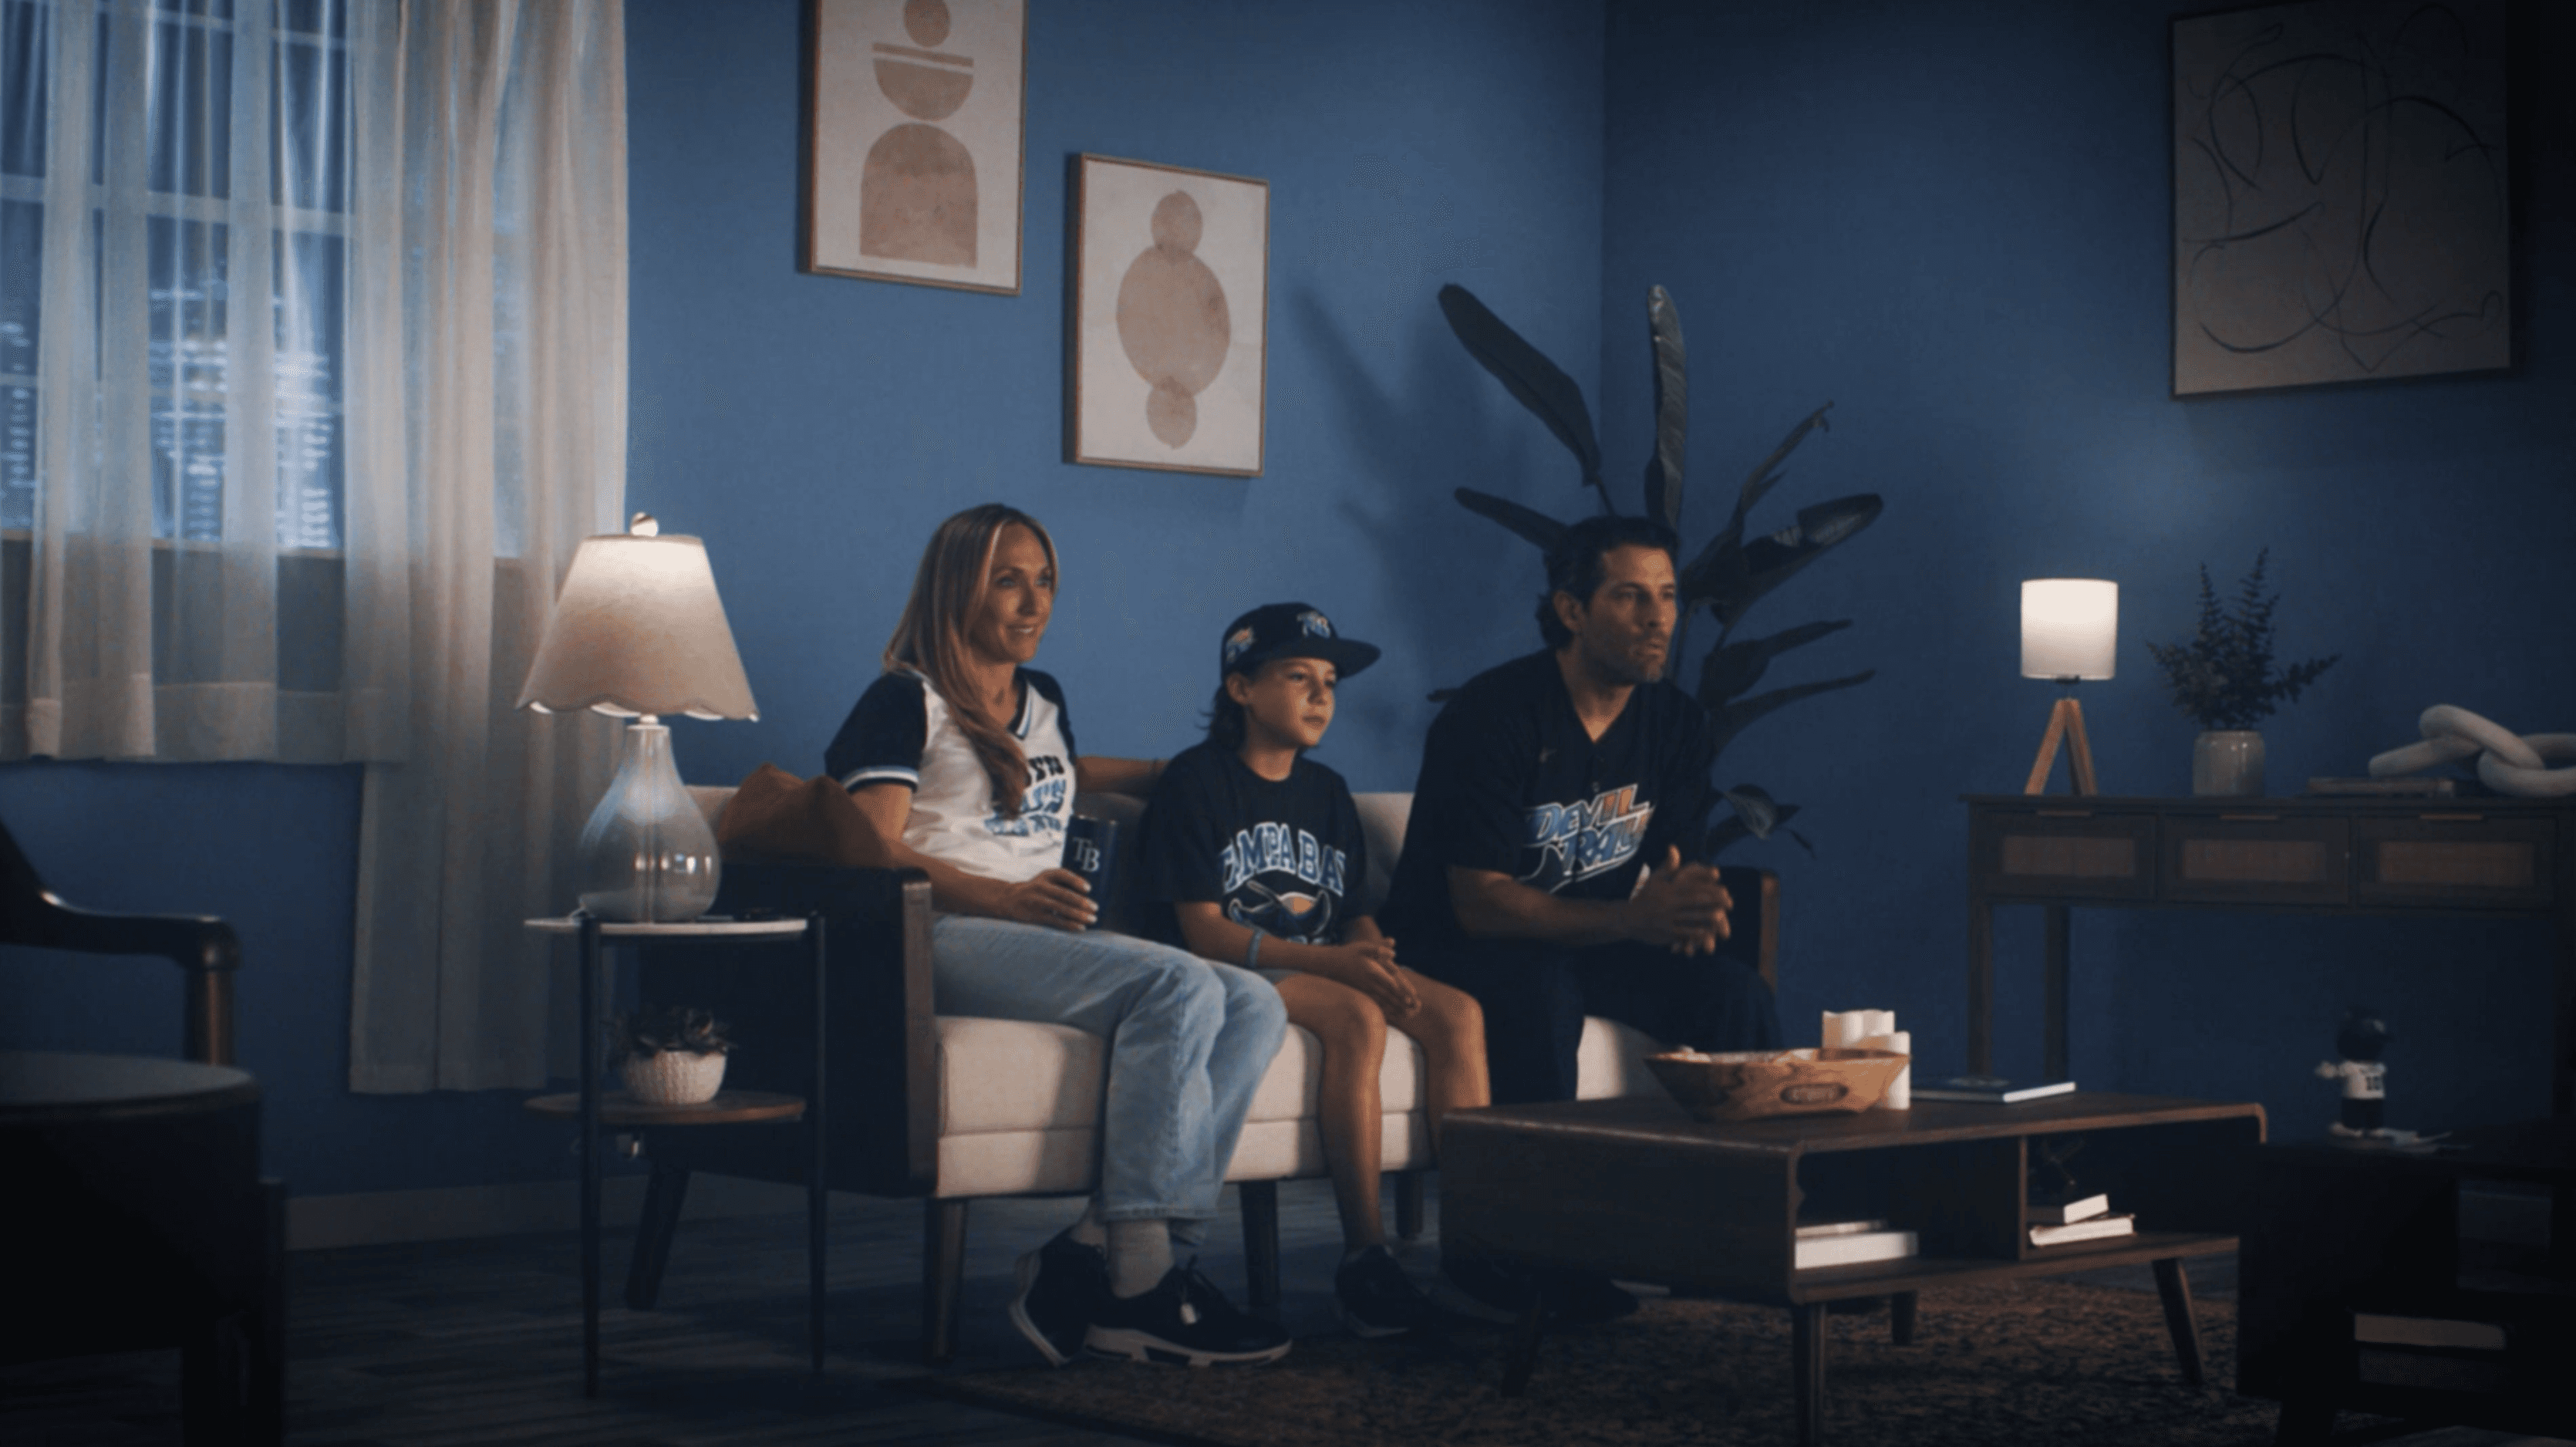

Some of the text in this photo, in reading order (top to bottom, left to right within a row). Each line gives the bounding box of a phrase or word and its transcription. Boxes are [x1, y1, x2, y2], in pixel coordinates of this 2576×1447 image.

[1524, 783, 1650, 847] DEVIL
[1072, 836, 1101, 873] TB
[1219, 821, 1296, 895] AMPA
